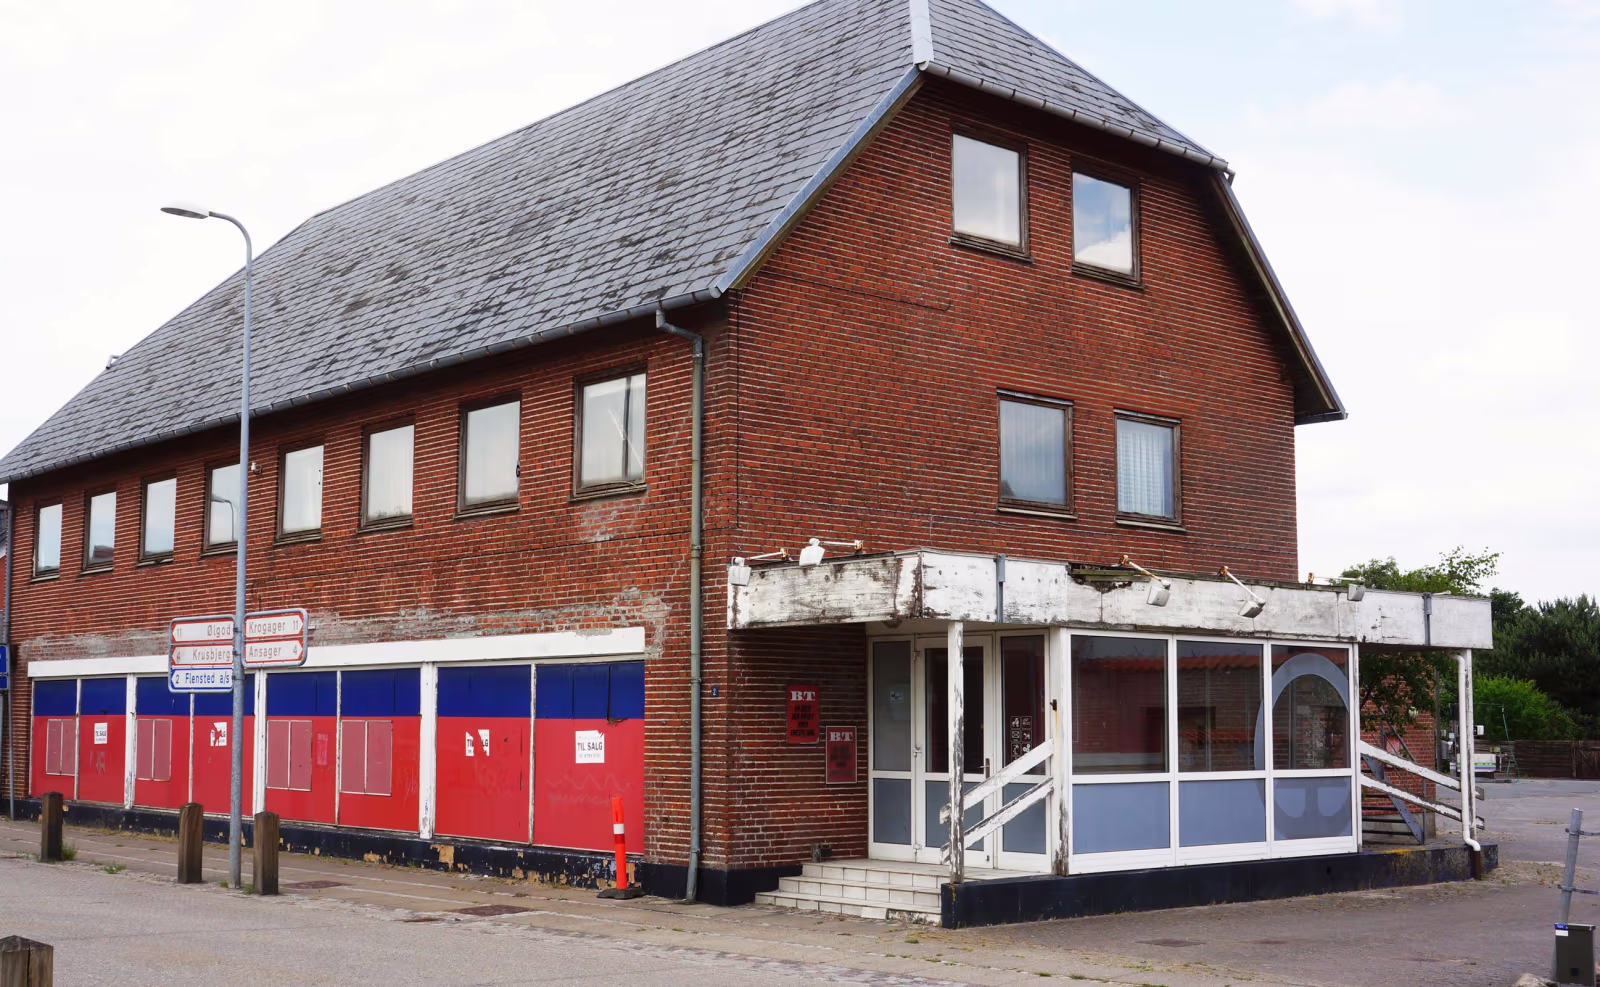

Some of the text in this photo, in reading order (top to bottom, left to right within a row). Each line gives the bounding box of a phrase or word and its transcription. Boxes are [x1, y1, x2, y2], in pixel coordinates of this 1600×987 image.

[177, 624, 231, 638] 11 Ølgod
[249, 620, 299, 635] Krogager 11
[192, 647, 231, 662] Krusbjerg
[249, 645, 298, 659] Ansager 4
[175, 672, 230, 684] 2 Flensted a/s
[577, 741, 603, 751] TIL SALG
